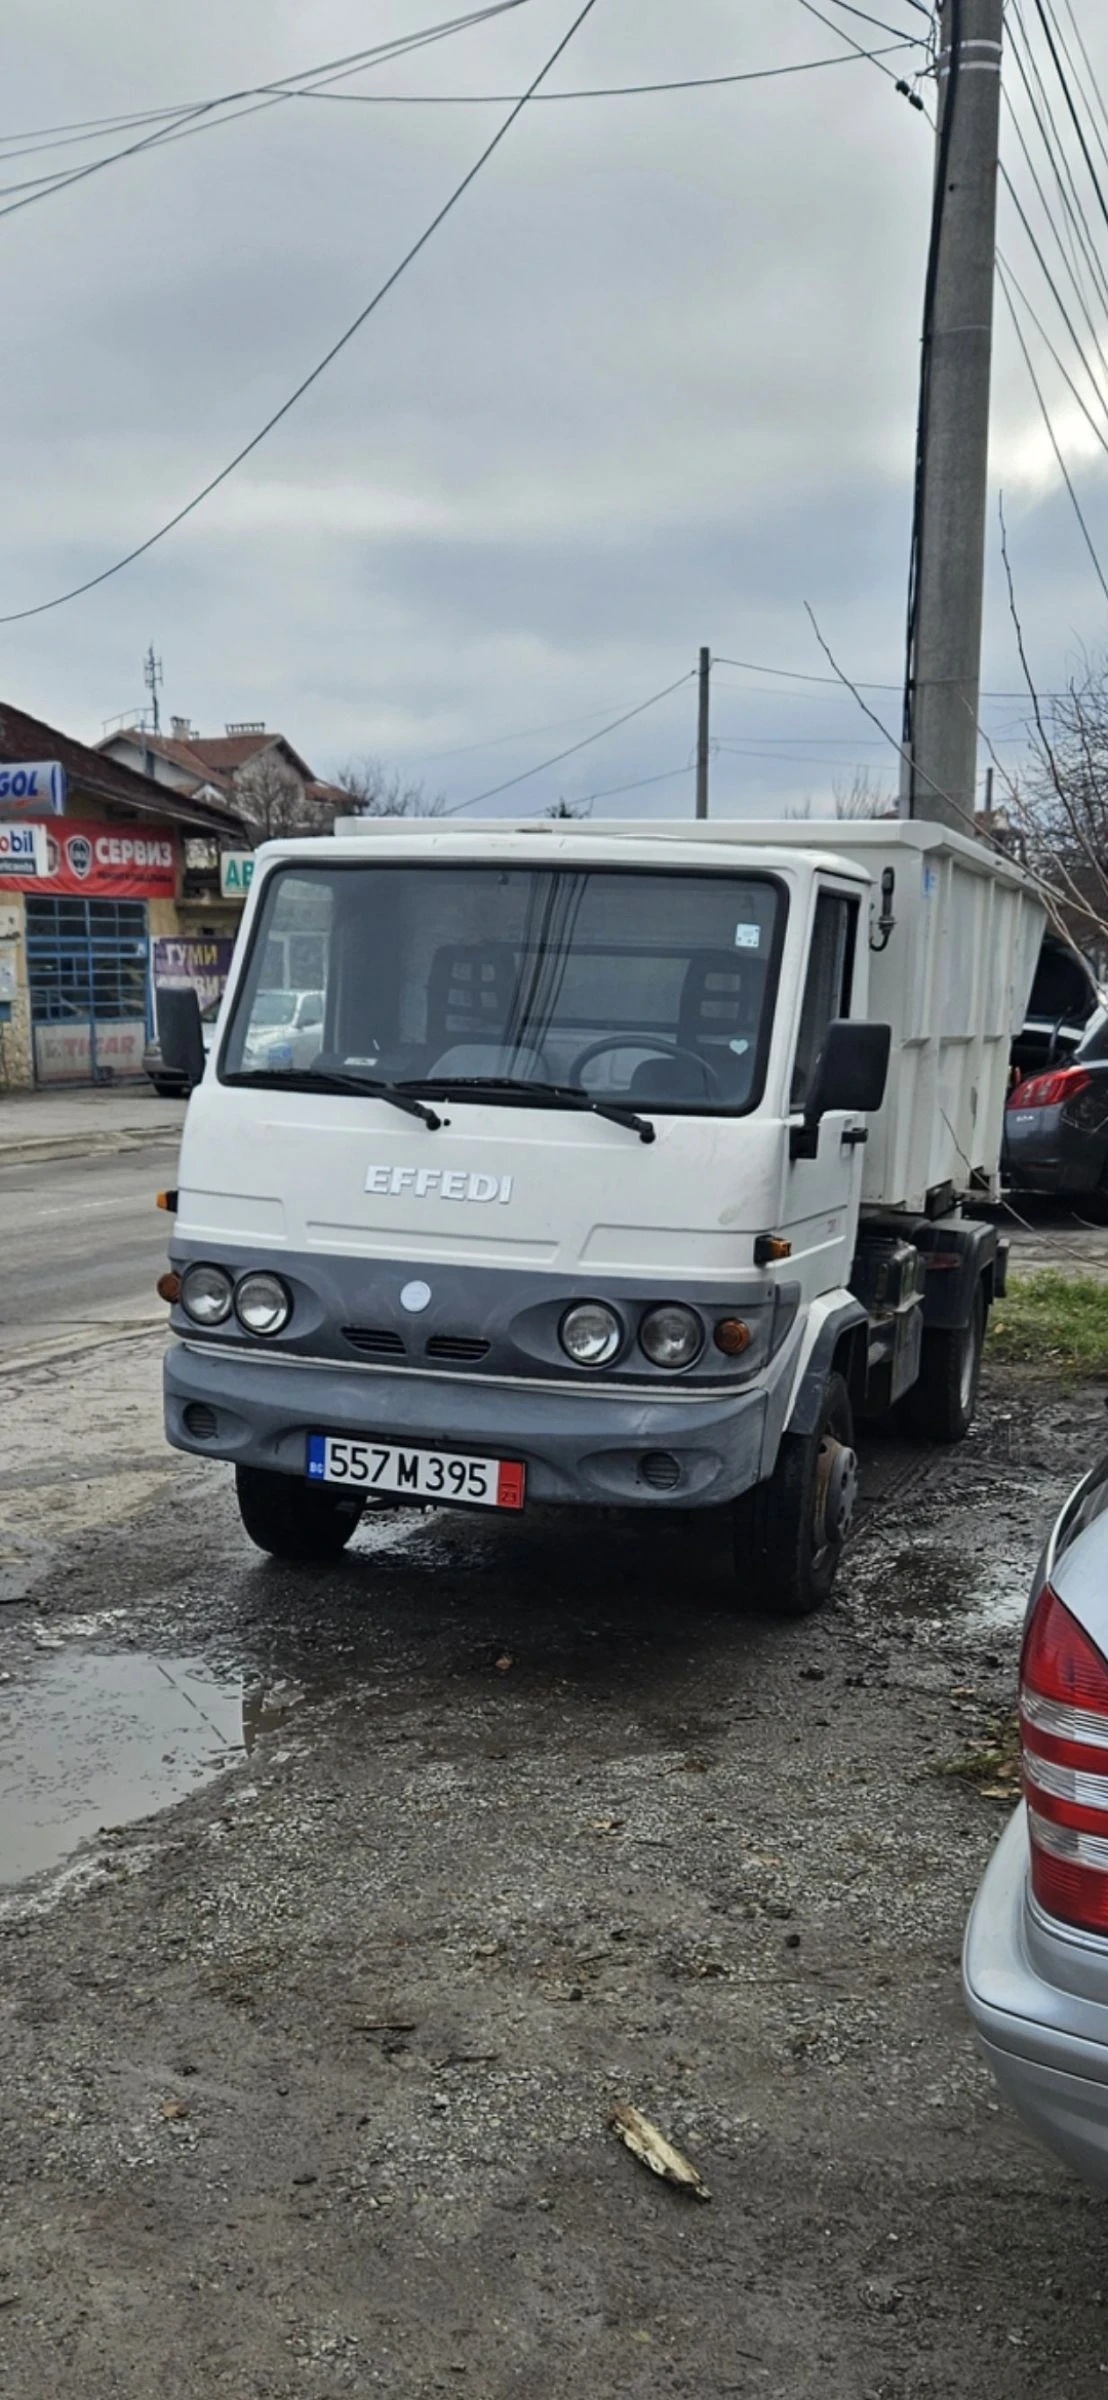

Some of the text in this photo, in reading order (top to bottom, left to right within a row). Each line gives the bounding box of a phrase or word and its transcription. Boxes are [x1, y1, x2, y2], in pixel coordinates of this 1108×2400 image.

[95, 837, 173, 867] СЕРВИЗ
[165, 943, 218, 966] ГУМИ
[364, 1165, 514, 1204] EFFEDI
[310, 1461, 323, 1474] BG
[330, 1443, 488, 1497] 557 M 395
